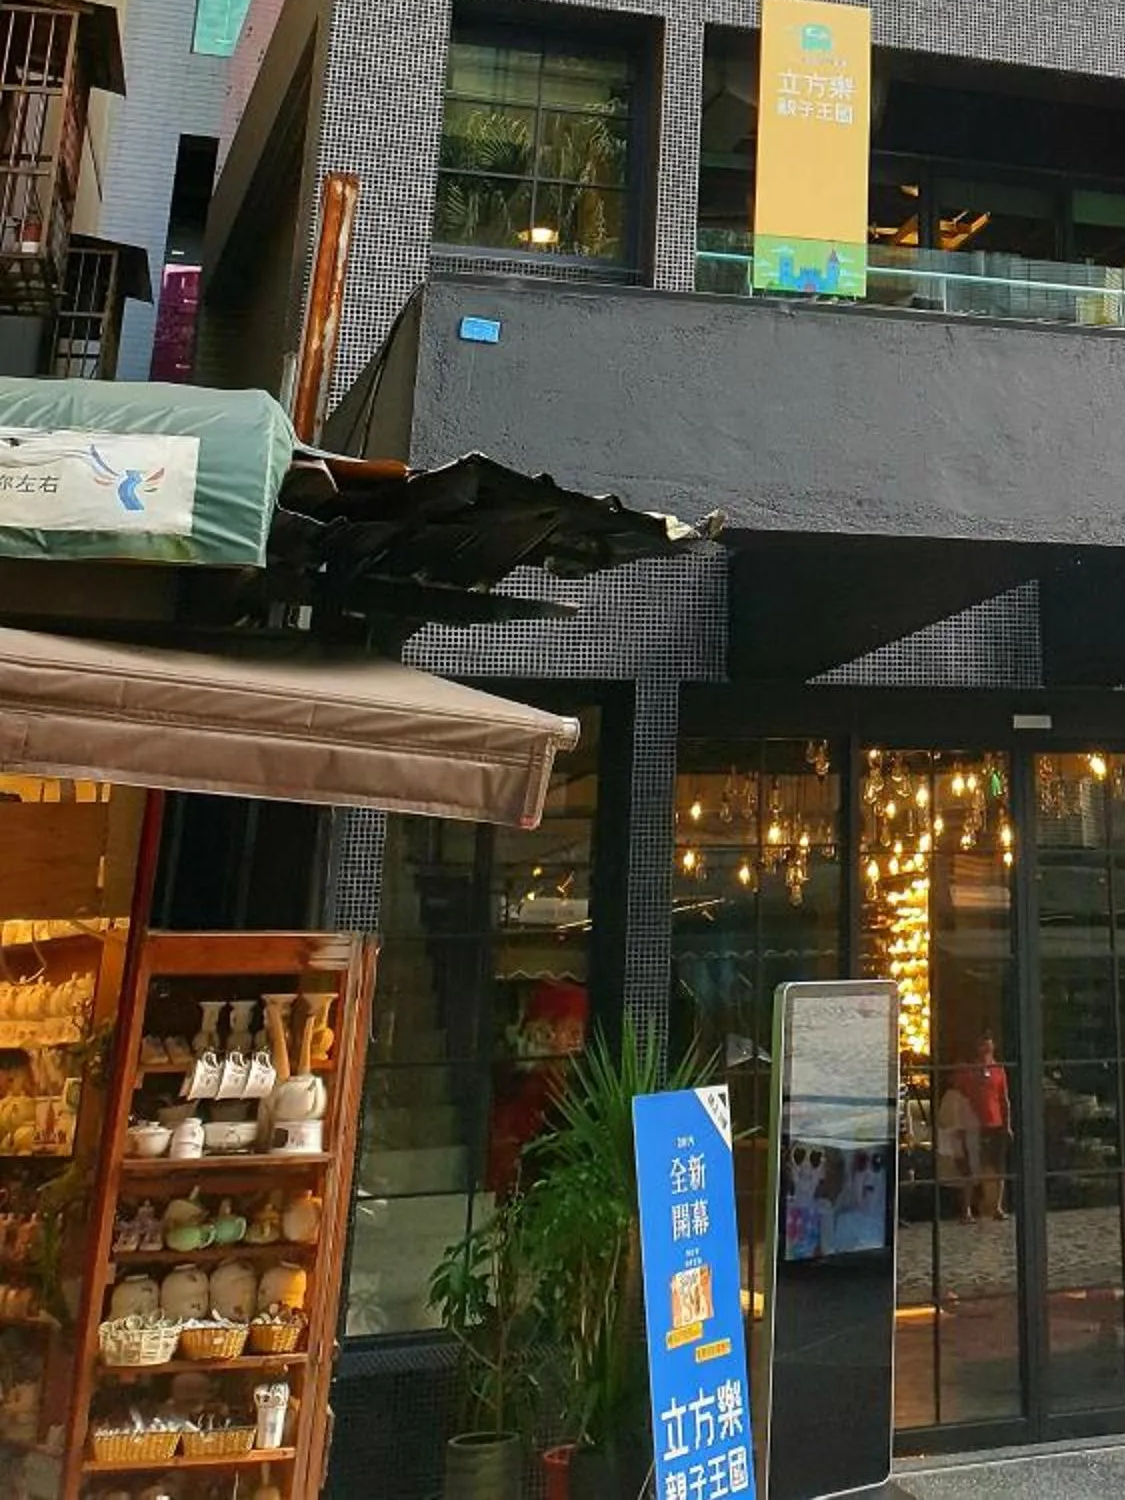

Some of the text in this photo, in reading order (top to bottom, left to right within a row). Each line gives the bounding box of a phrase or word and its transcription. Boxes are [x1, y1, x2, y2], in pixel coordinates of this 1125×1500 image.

[776, 67, 857, 99] 立方樂
[671, 1153, 705, 1195] 全新
[671, 1198, 709, 1240] 開幕
[661, 1380, 744, 1460] 立方樂
[665, 1445, 749, 1500] 親子王國
